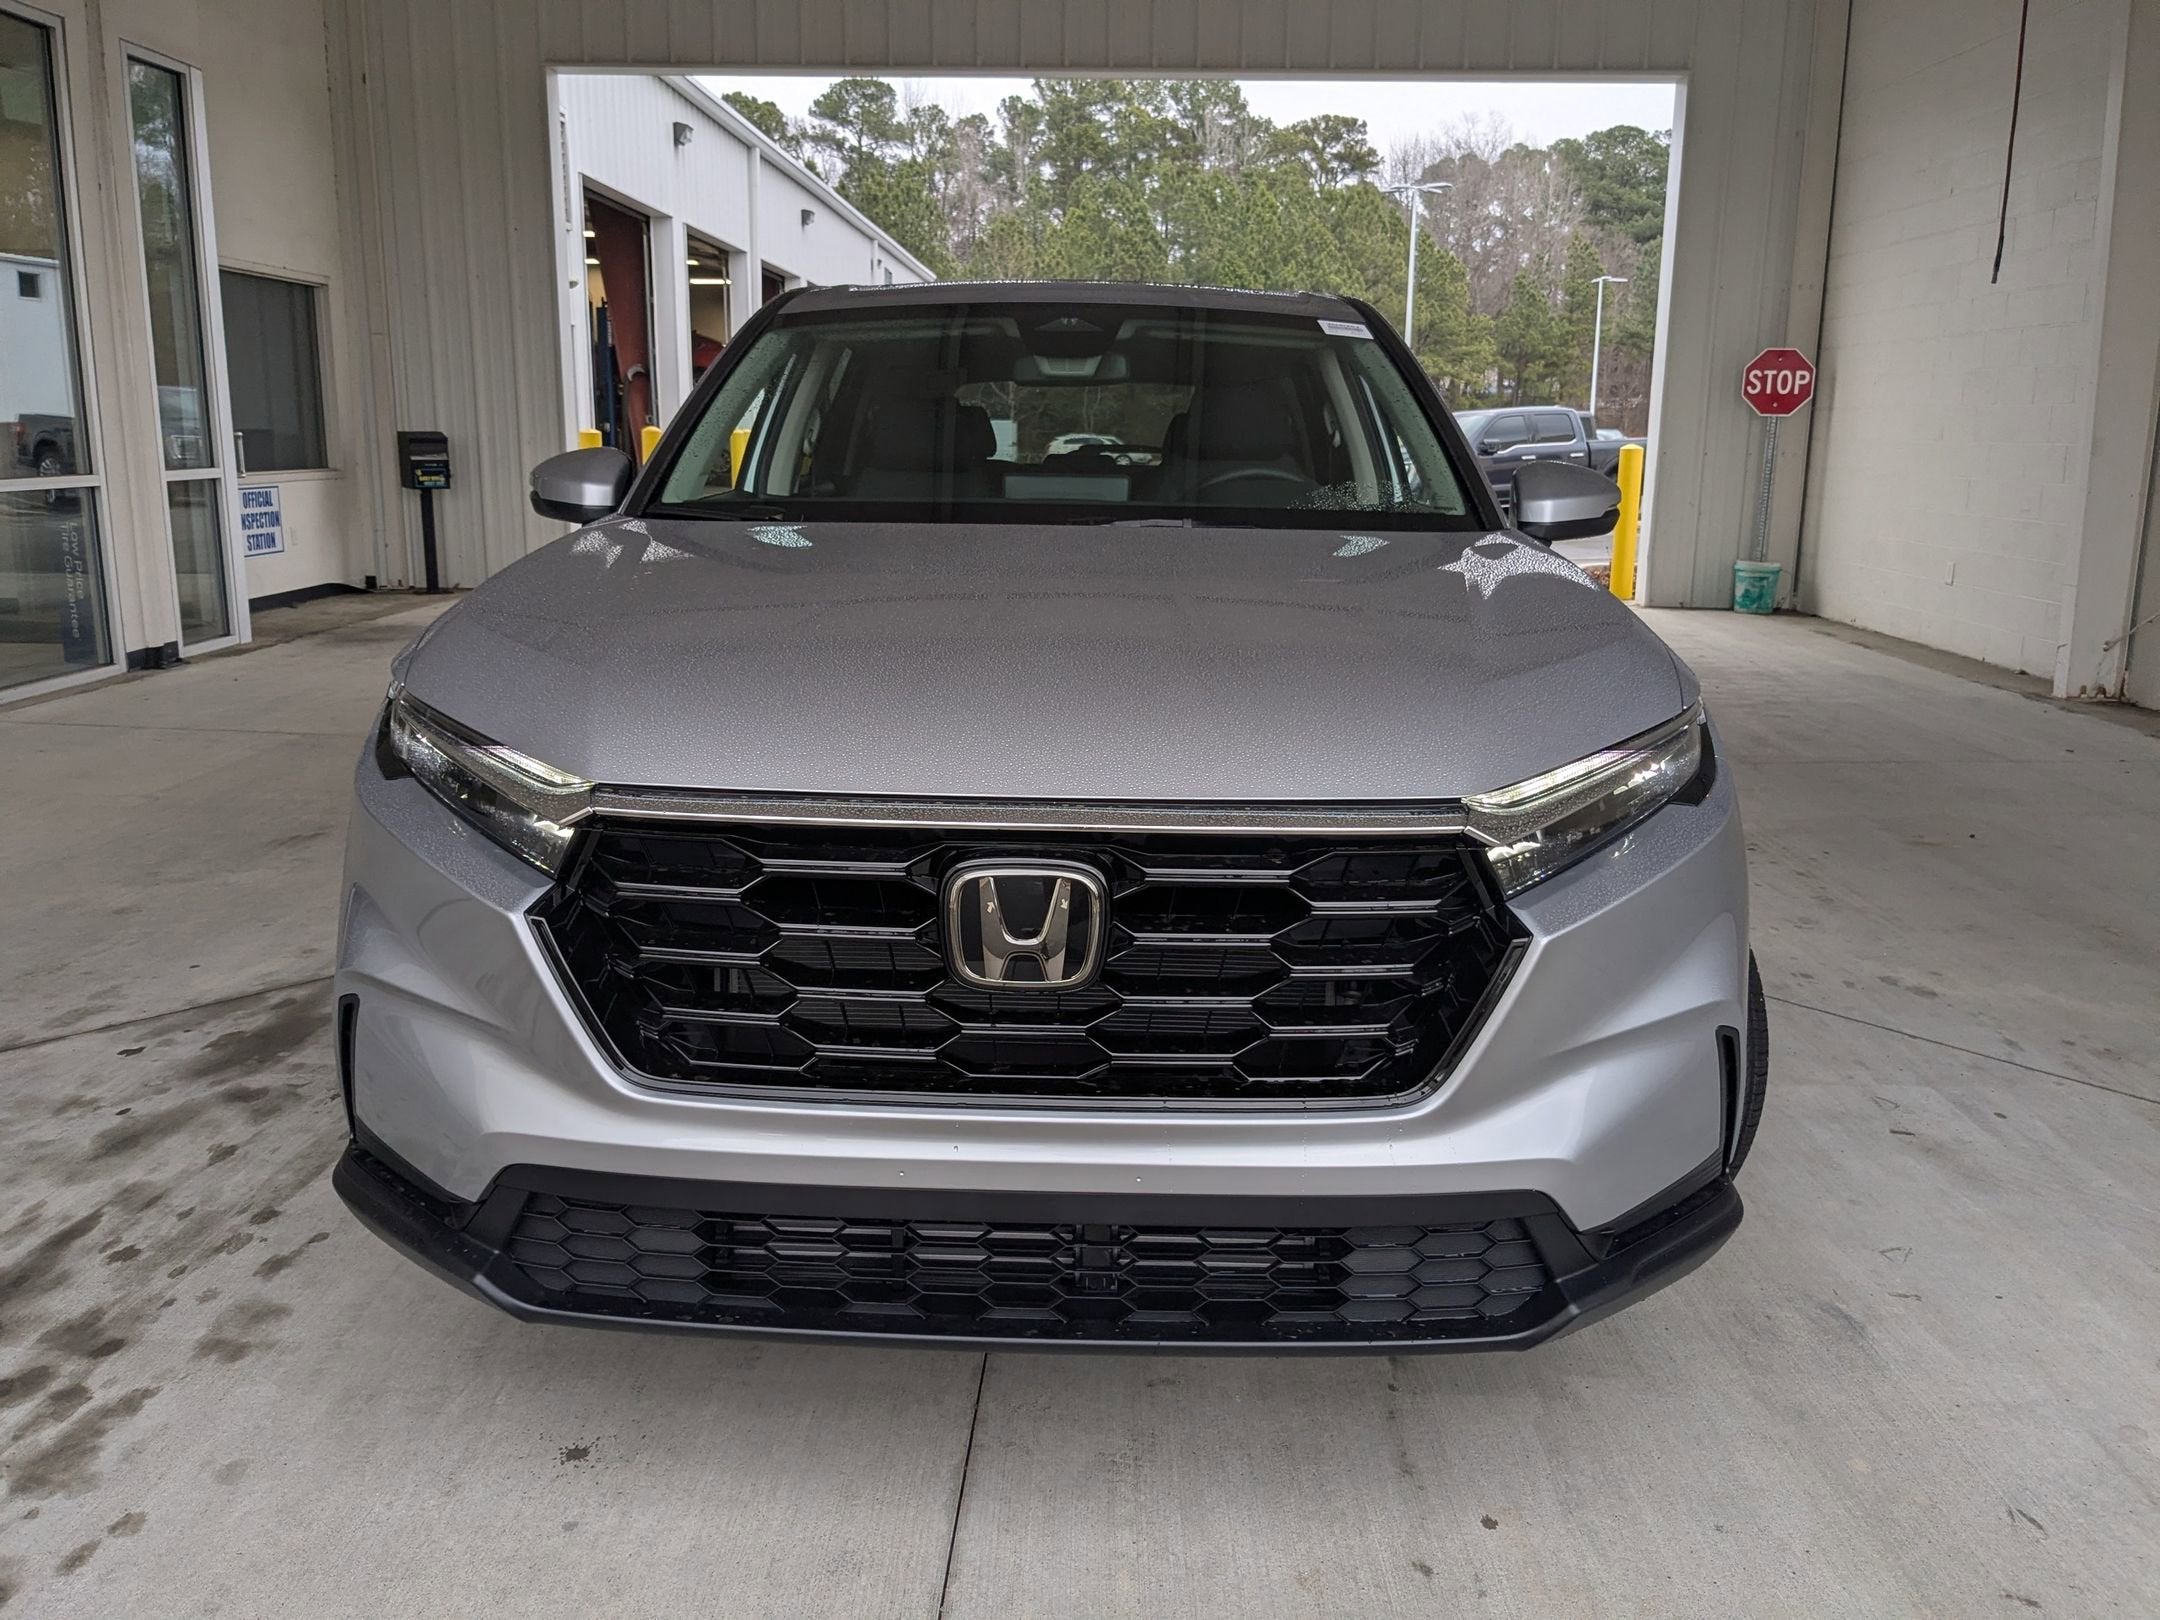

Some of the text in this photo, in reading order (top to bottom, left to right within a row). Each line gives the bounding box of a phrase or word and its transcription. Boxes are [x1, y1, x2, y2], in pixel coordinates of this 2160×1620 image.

[1746, 369, 1811, 395] STOP
[242, 490, 273, 508] OFFICIAL
[241, 511, 280, 530] NSPECTION
[246, 532, 276, 551] STATION
[69, 521, 85, 600] Low Price
[60, 521, 81, 639] Tire Guarantee
